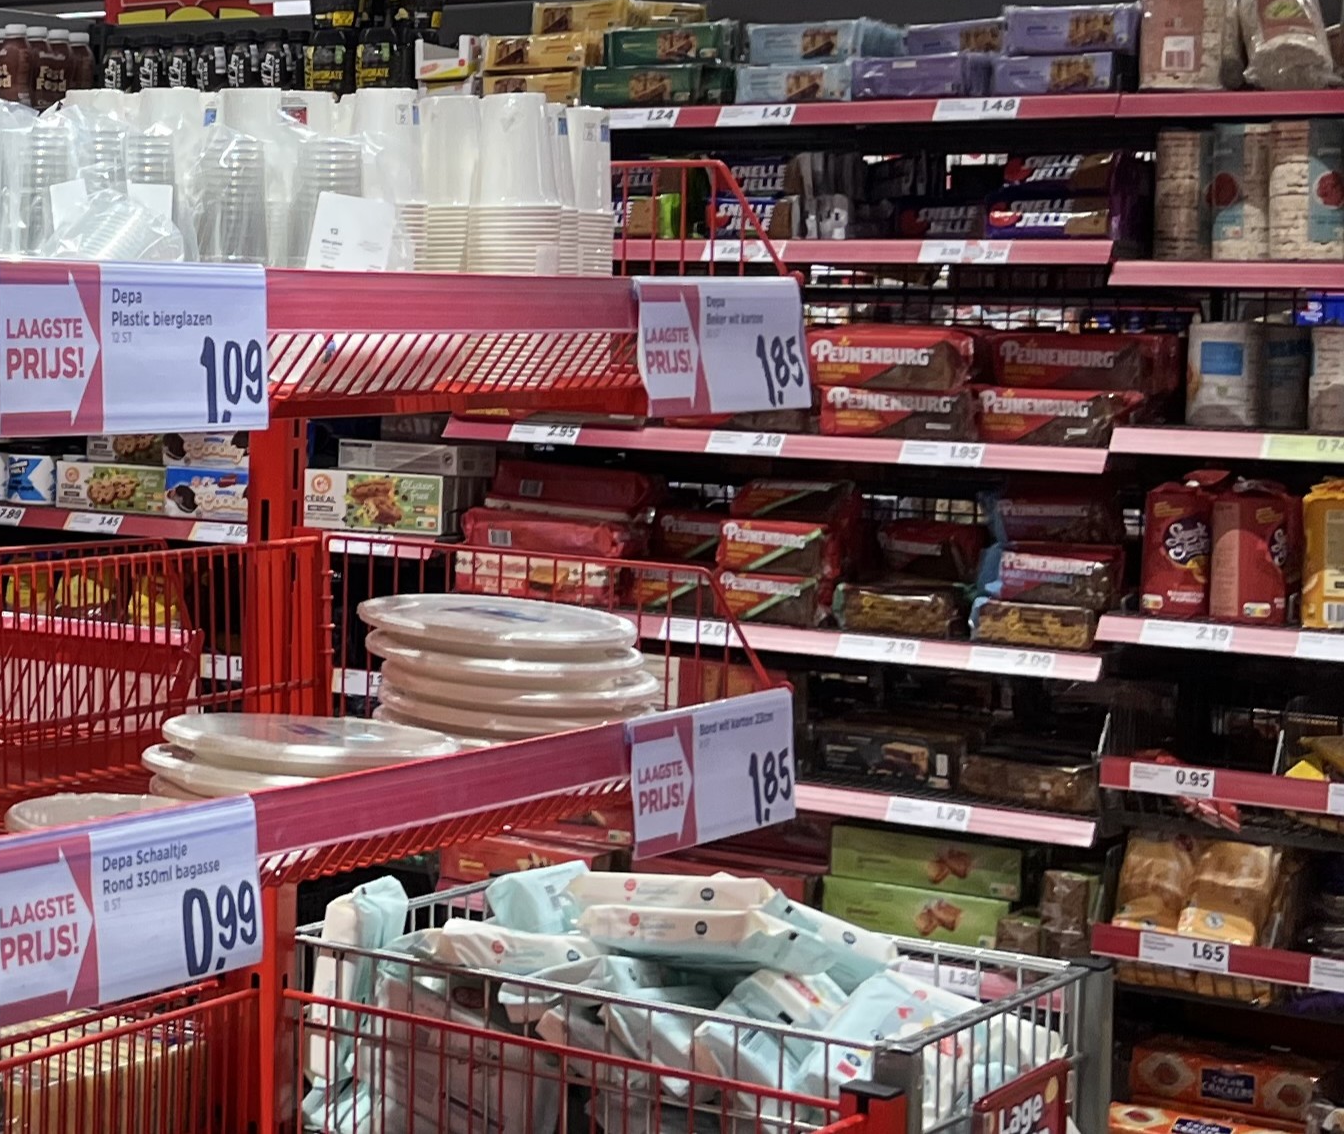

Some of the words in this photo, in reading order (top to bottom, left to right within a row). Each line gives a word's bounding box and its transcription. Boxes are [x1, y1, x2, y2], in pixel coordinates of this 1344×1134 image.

[731, 164, 787, 178] SNELLE
[741, 177, 785, 191] JELLE
[111, 288, 143, 306] Depa
[6, 318, 83, 339] LAAGSTE
[111, 311, 150, 327] Plastic
[153, 310, 213, 330] bierglazen
[644, 327, 689, 344] LAAGSTE
[6, 347, 85, 380] PRIJS!
[646, 349, 693, 375] PRIJS!
[756, 334, 804, 407] 1.85
[200, 335, 263, 424] 1.09
[637, 759, 683, 785] LAAGSTE
[748, 746, 792, 826] 1.85
[638, 782, 684, 816] PRIJS!
[102, 855, 133, 872] Depa
[135, 842, 188, 866] Schaaltje
[103, 876, 133, 895] Rond
[136, 868, 173, 887] 350ml
[175, 859, 221, 881] bagasse
[181, 879, 258, 977] 0.99
[0, 922, 80, 970] PRIJS!
[998, 1095, 1045, 1132] Lage
